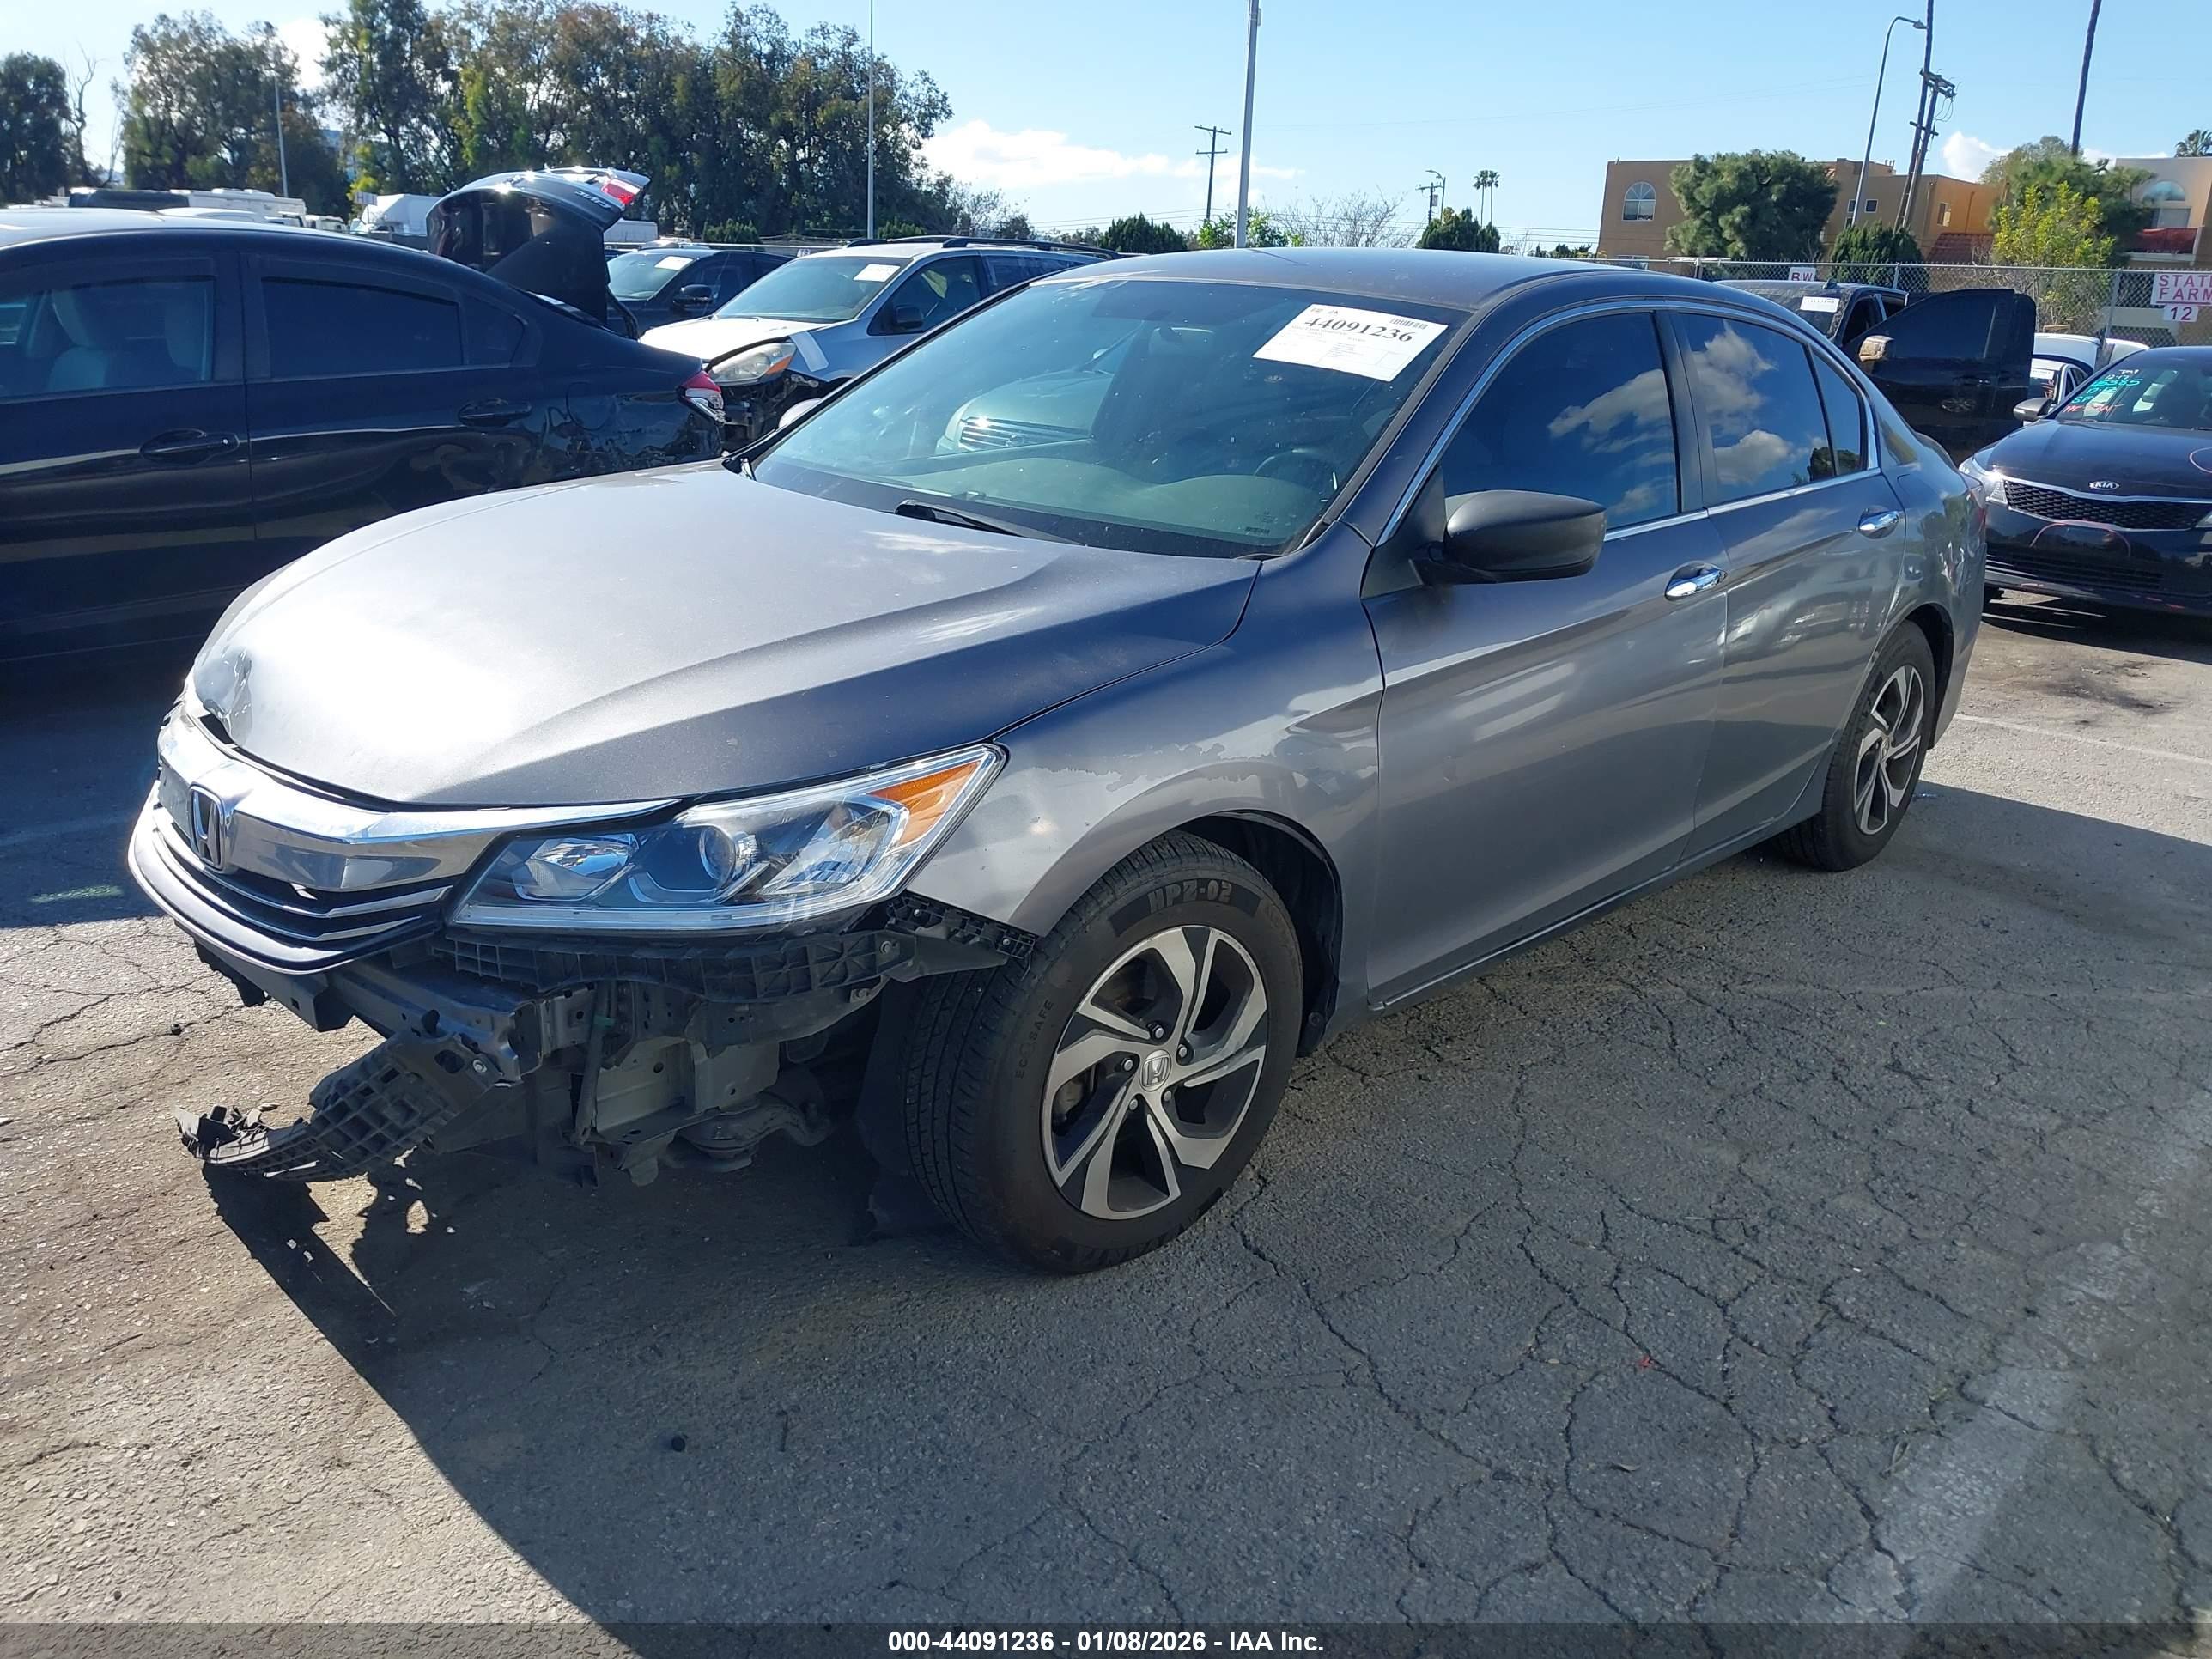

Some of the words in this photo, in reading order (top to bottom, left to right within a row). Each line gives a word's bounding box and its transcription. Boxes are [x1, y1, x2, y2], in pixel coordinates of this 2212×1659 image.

[2159, 274, 2212, 288] STAT
[2171, 306, 2192, 321] 12
[1305, 317, 1416, 343] 44091236
